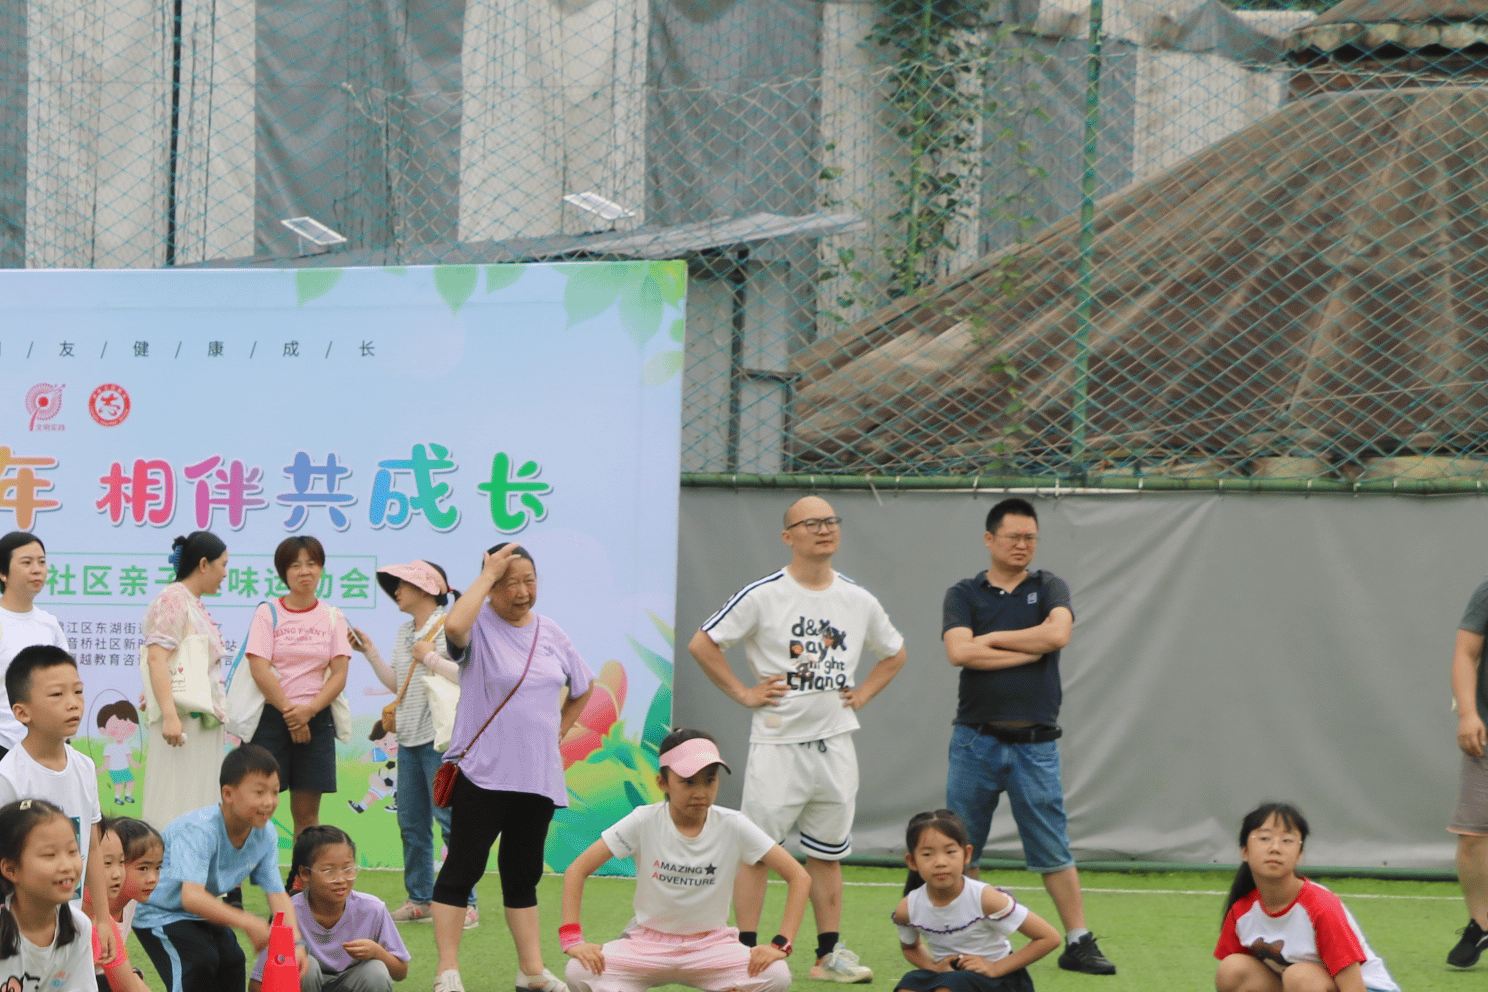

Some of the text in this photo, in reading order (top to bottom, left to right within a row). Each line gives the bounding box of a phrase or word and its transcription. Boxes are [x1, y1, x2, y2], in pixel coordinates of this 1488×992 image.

[95, 442, 550, 531] 相伴共成长
[653, 860, 703, 874] AMAZING
[651, 872, 716, 887] ADVENTURE
